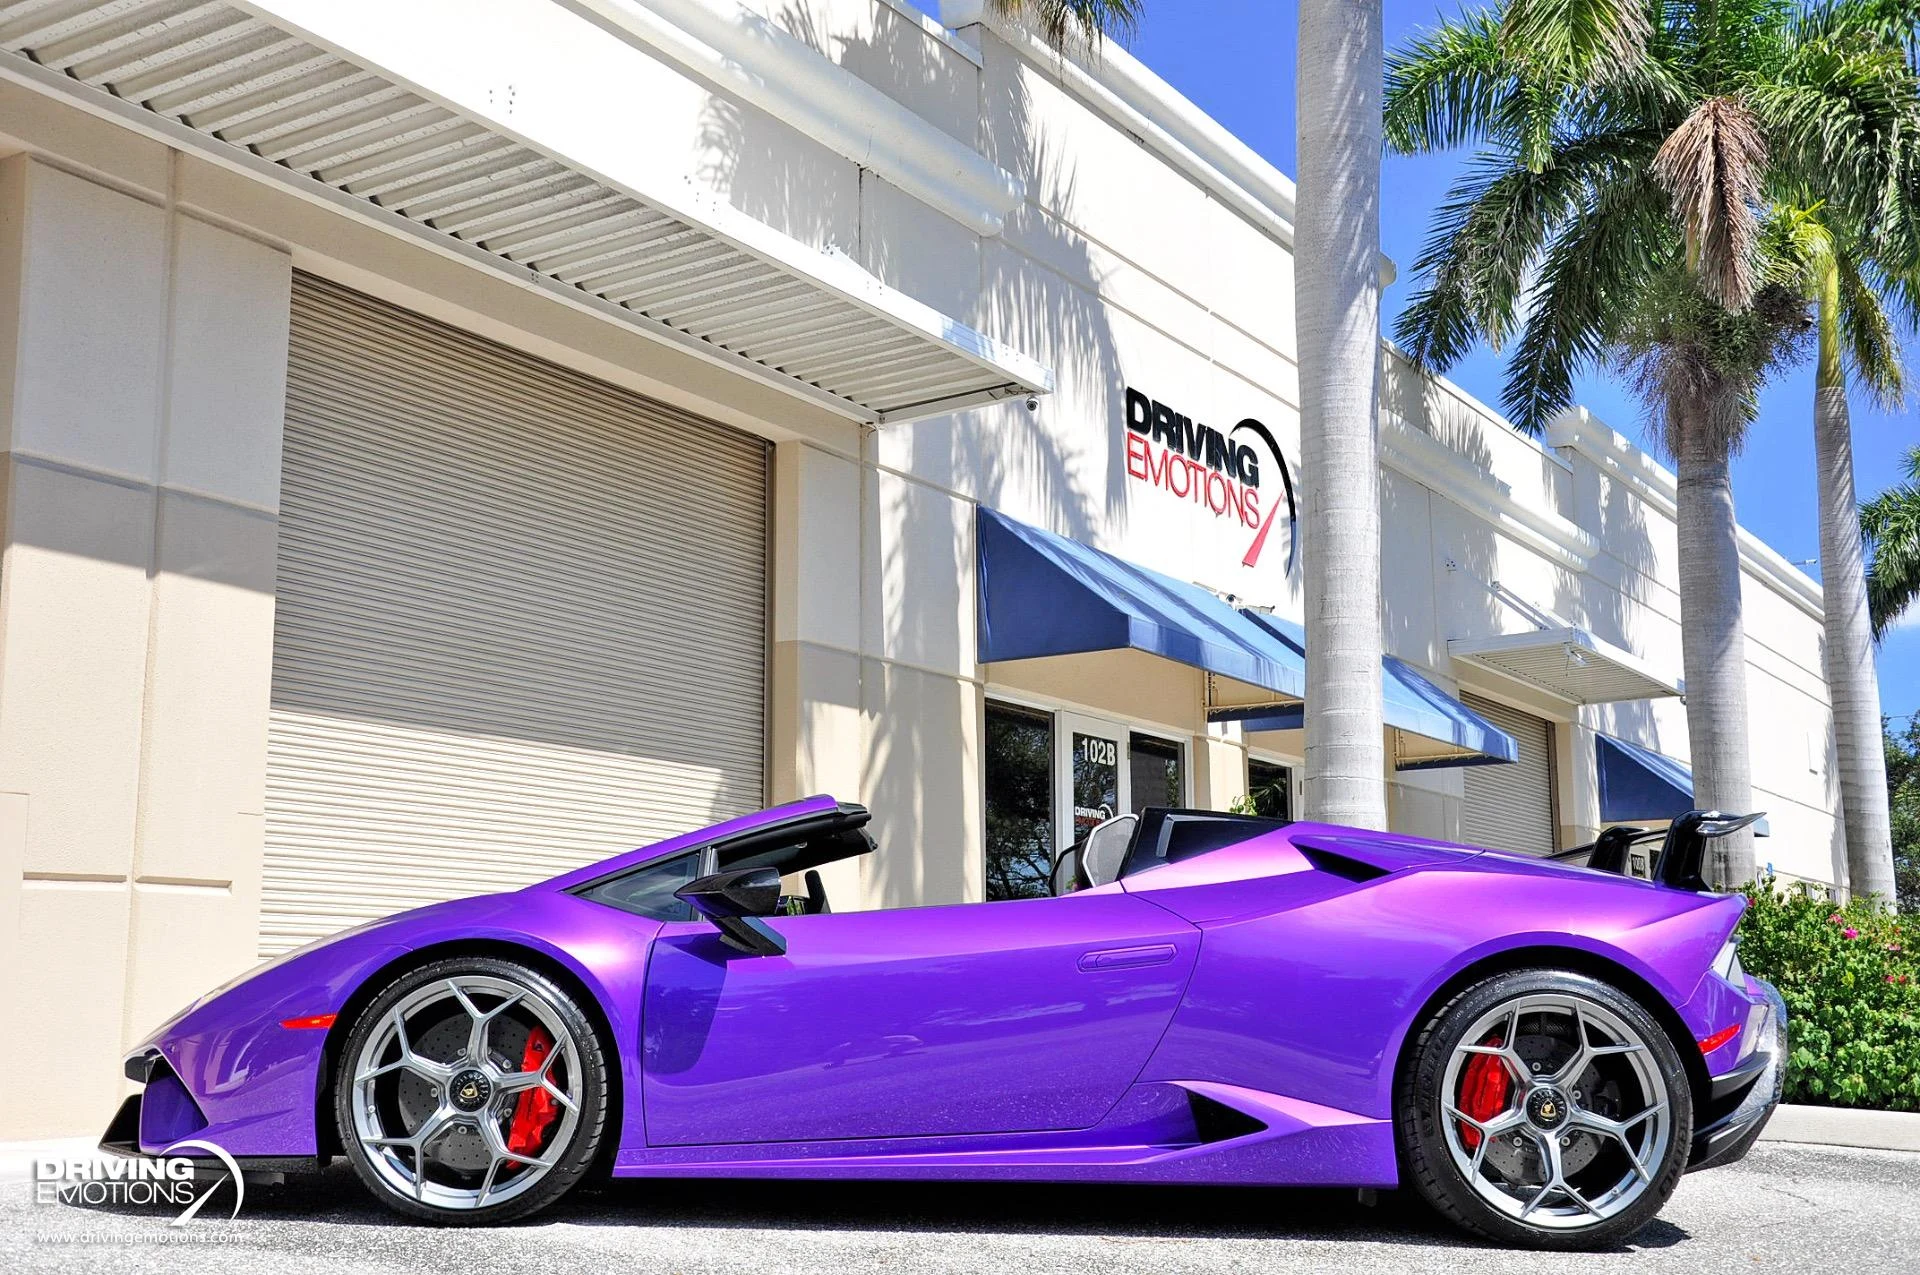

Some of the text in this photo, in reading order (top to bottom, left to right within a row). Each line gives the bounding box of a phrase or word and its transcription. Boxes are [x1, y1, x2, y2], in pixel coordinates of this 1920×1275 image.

[1126, 386, 1260, 489] DRIVING
[1127, 431, 1260, 529] EMOTIONS
[1081, 738, 1116, 766] 102B
[1074, 806, 1106, 820] DRIVING
